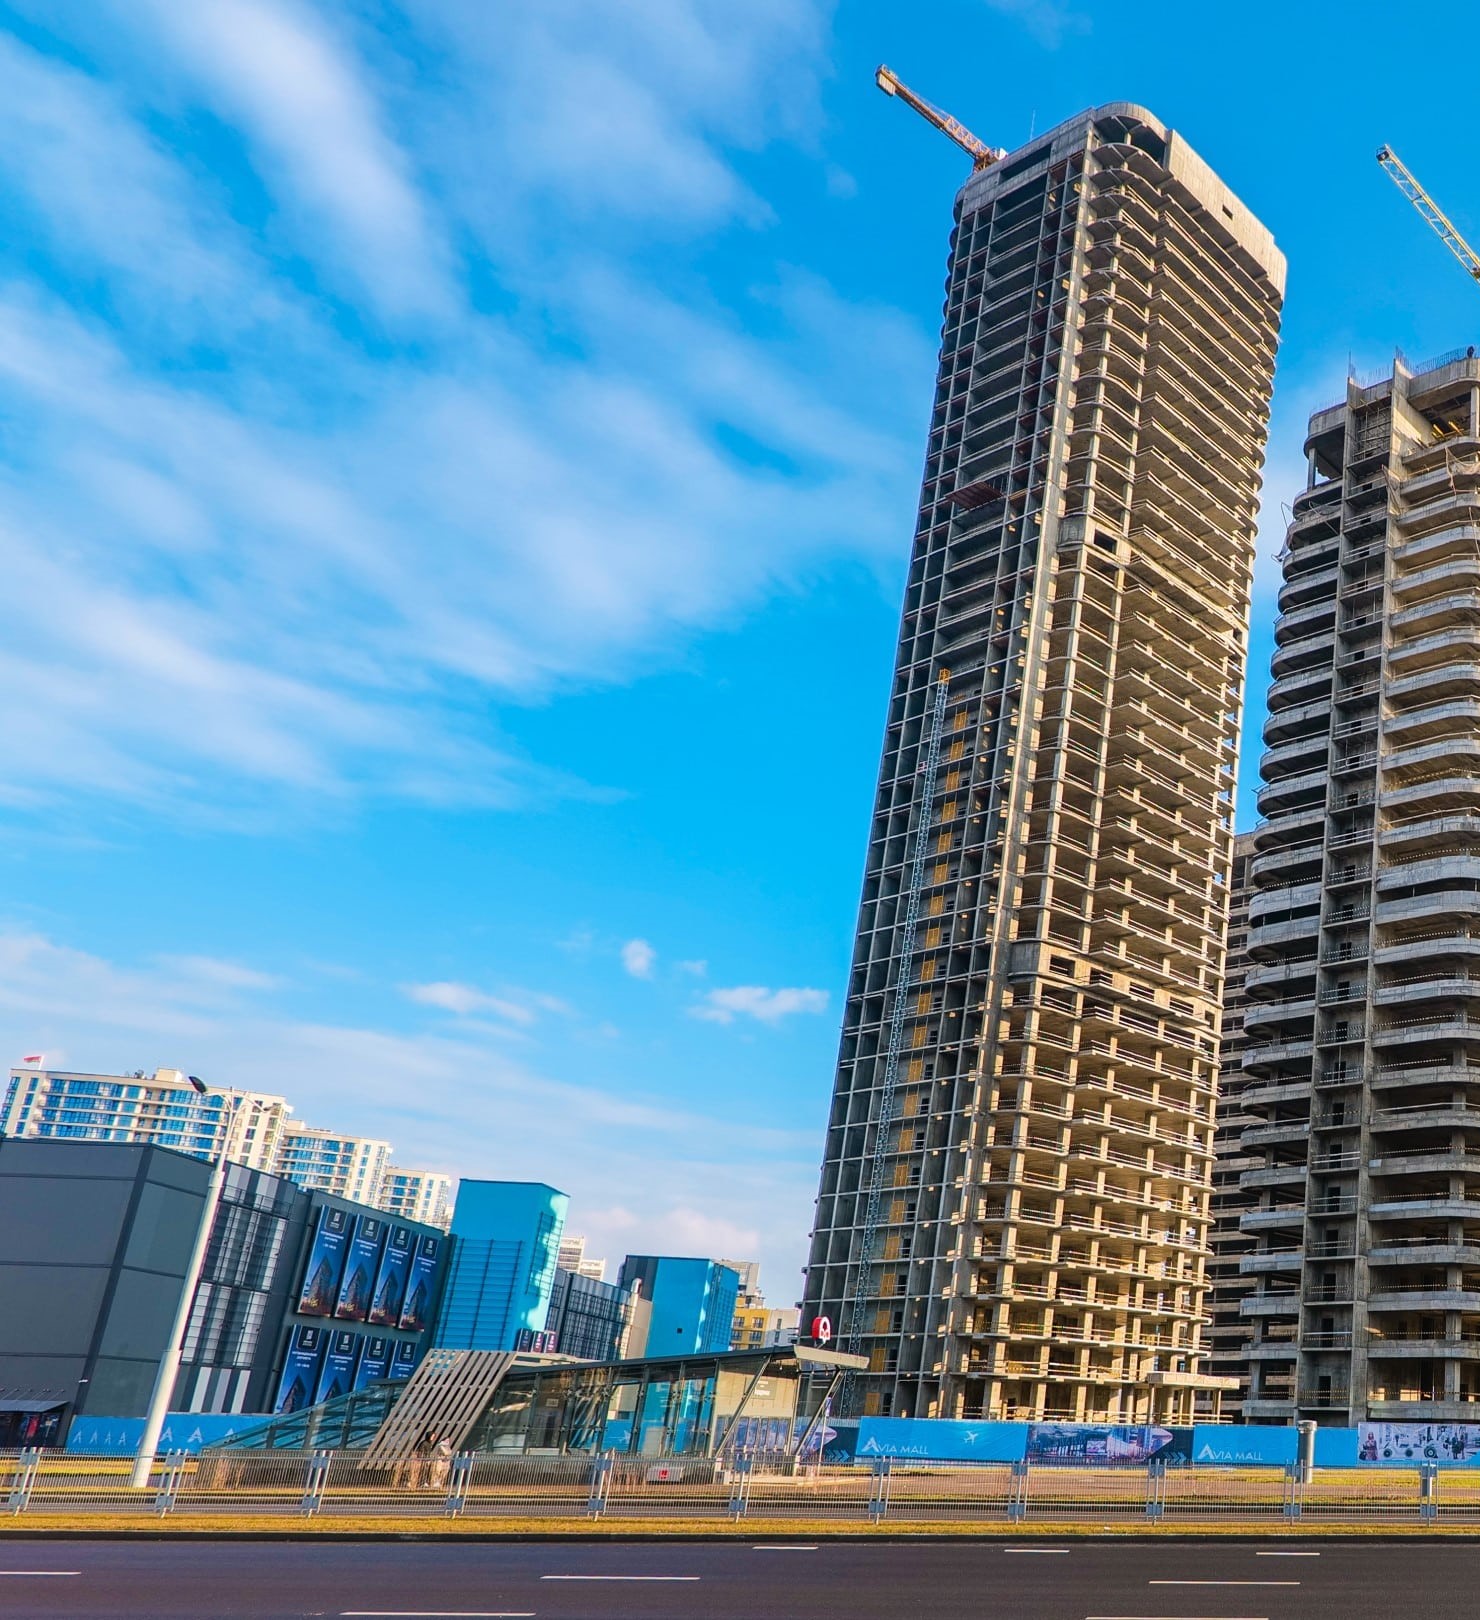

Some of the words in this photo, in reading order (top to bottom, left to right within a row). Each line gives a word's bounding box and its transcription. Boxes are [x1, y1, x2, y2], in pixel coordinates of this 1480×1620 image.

[861, 1436, 897, 1453] AVIA
[900, 1445, 929, 1455] MALL
[1197, 1443, 1232, 1461] AVIA
[1235, 1451, 1264, 1461] MALL
